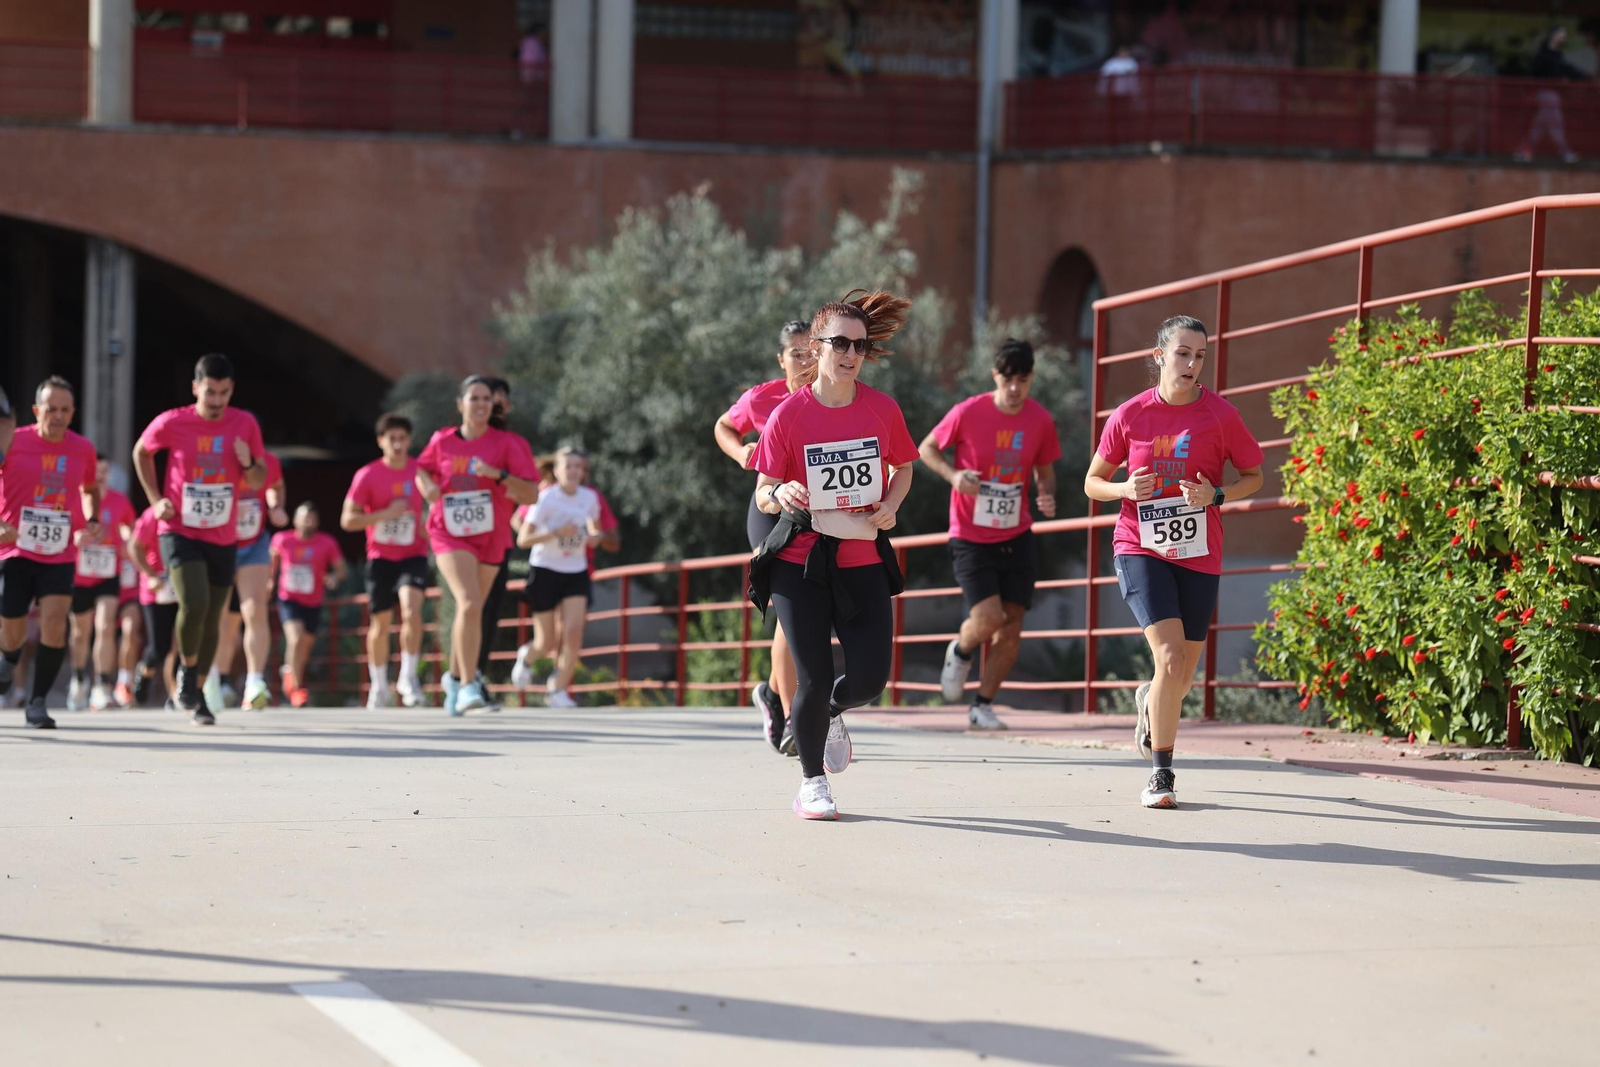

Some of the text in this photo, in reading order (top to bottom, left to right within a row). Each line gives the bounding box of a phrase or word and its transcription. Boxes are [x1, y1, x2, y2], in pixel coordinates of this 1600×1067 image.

[996, 429, 1024, 450] WE
[1153, 434, 1191, 458] WE
[809, 453, 843, 465] UMA
[821, 462, 873, 491] 208
[1157, 460, 1184, 477] RUN
[192, 500, 225, 517] 439
[452, 506, 486, 524] 608
[985, 499, 1016, 515] 182
[1141, 508, 1173, 520] UMA
[28, 525, 62, 543] 438
[1153, 517, 1197, 544] 589
